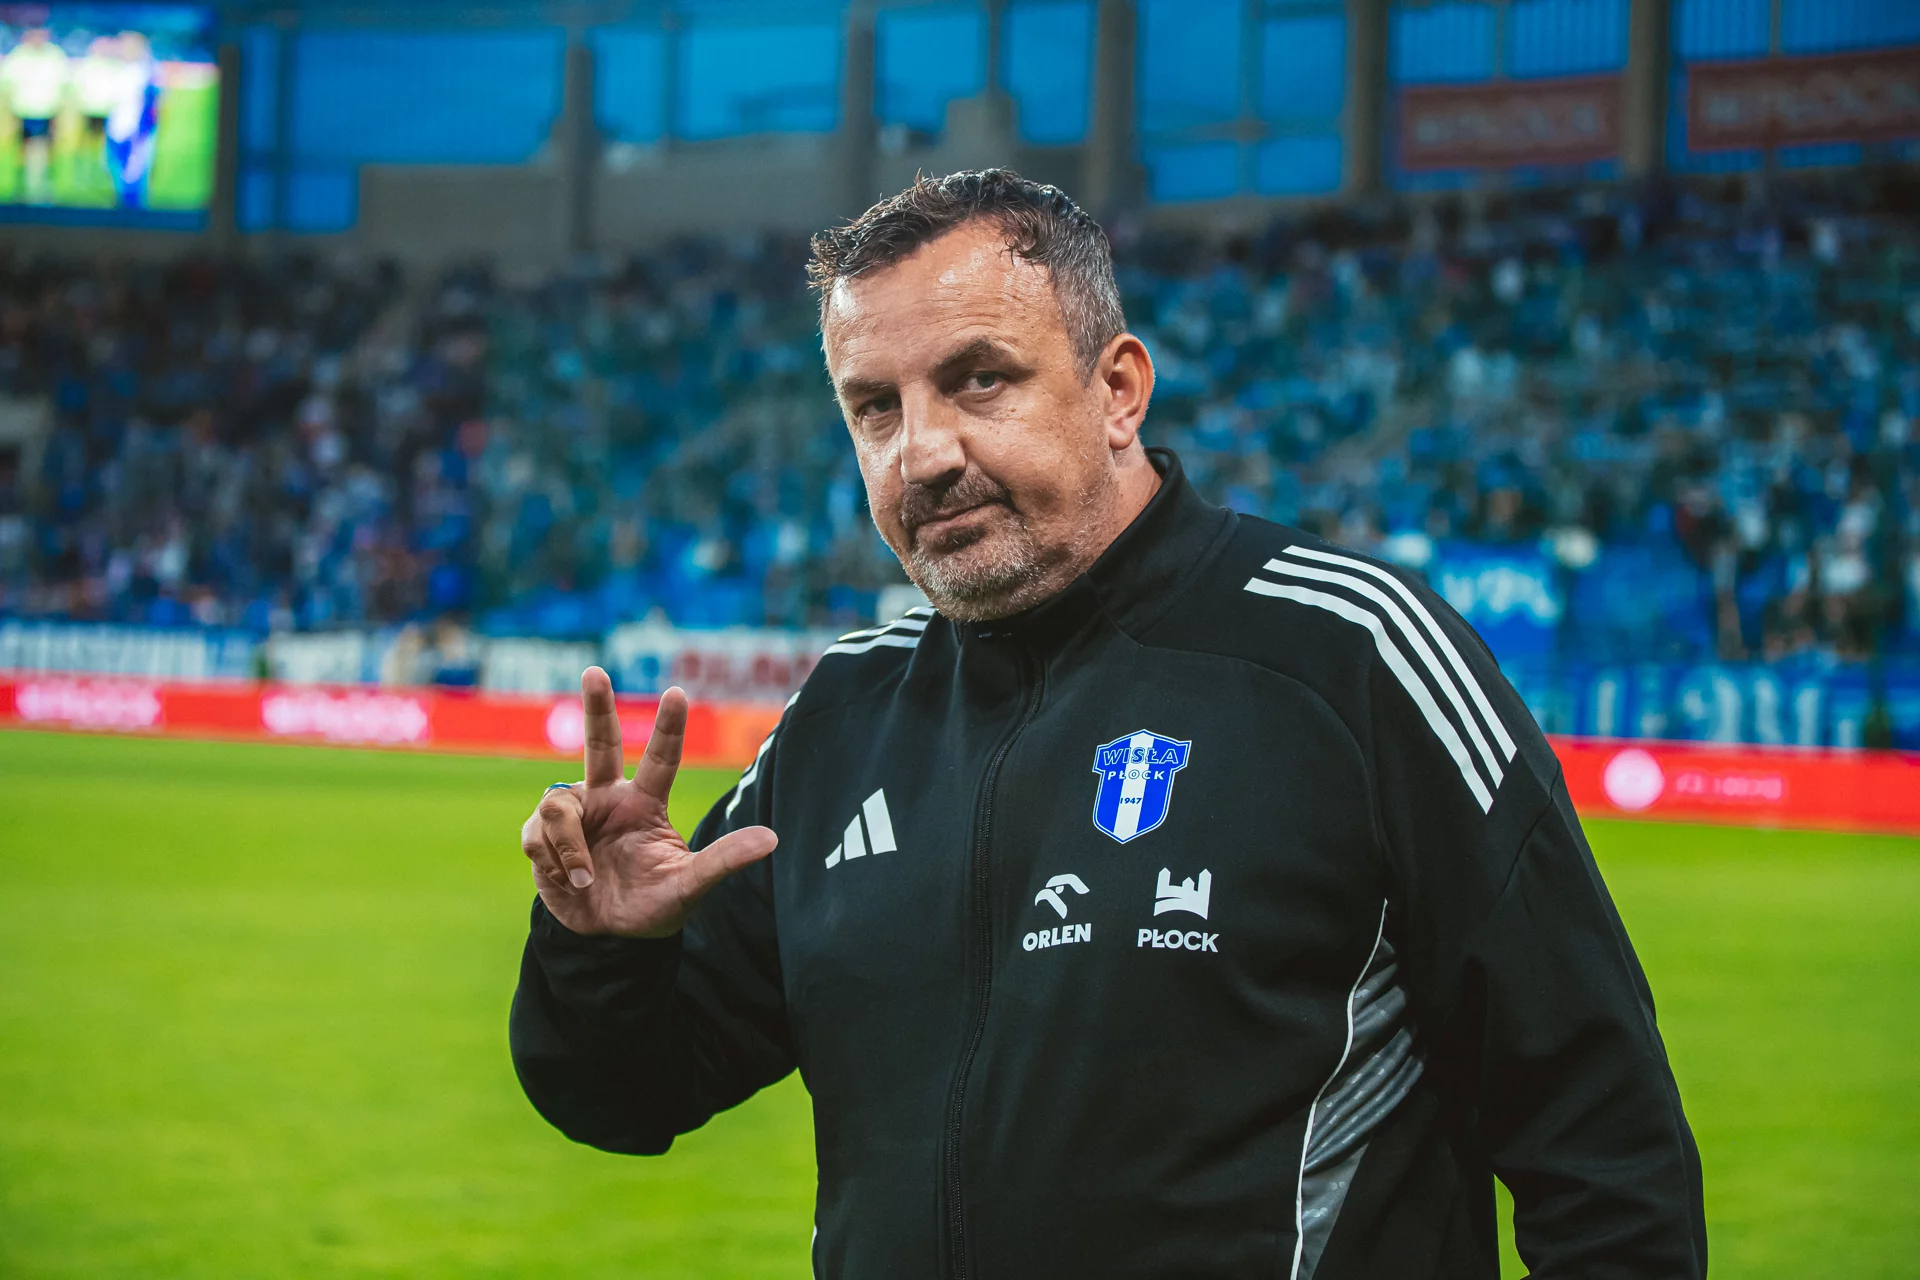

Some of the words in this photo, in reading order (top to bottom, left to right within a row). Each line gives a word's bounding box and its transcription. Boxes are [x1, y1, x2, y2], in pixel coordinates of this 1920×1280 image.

[1103, 747, 1179, 766] WISŁA
[1107, 769, 1165, 780] PŁOCK
[1022, 923, 1092, 951] ORLEN
[1137, 928, 1219, 952] PŁOCK
